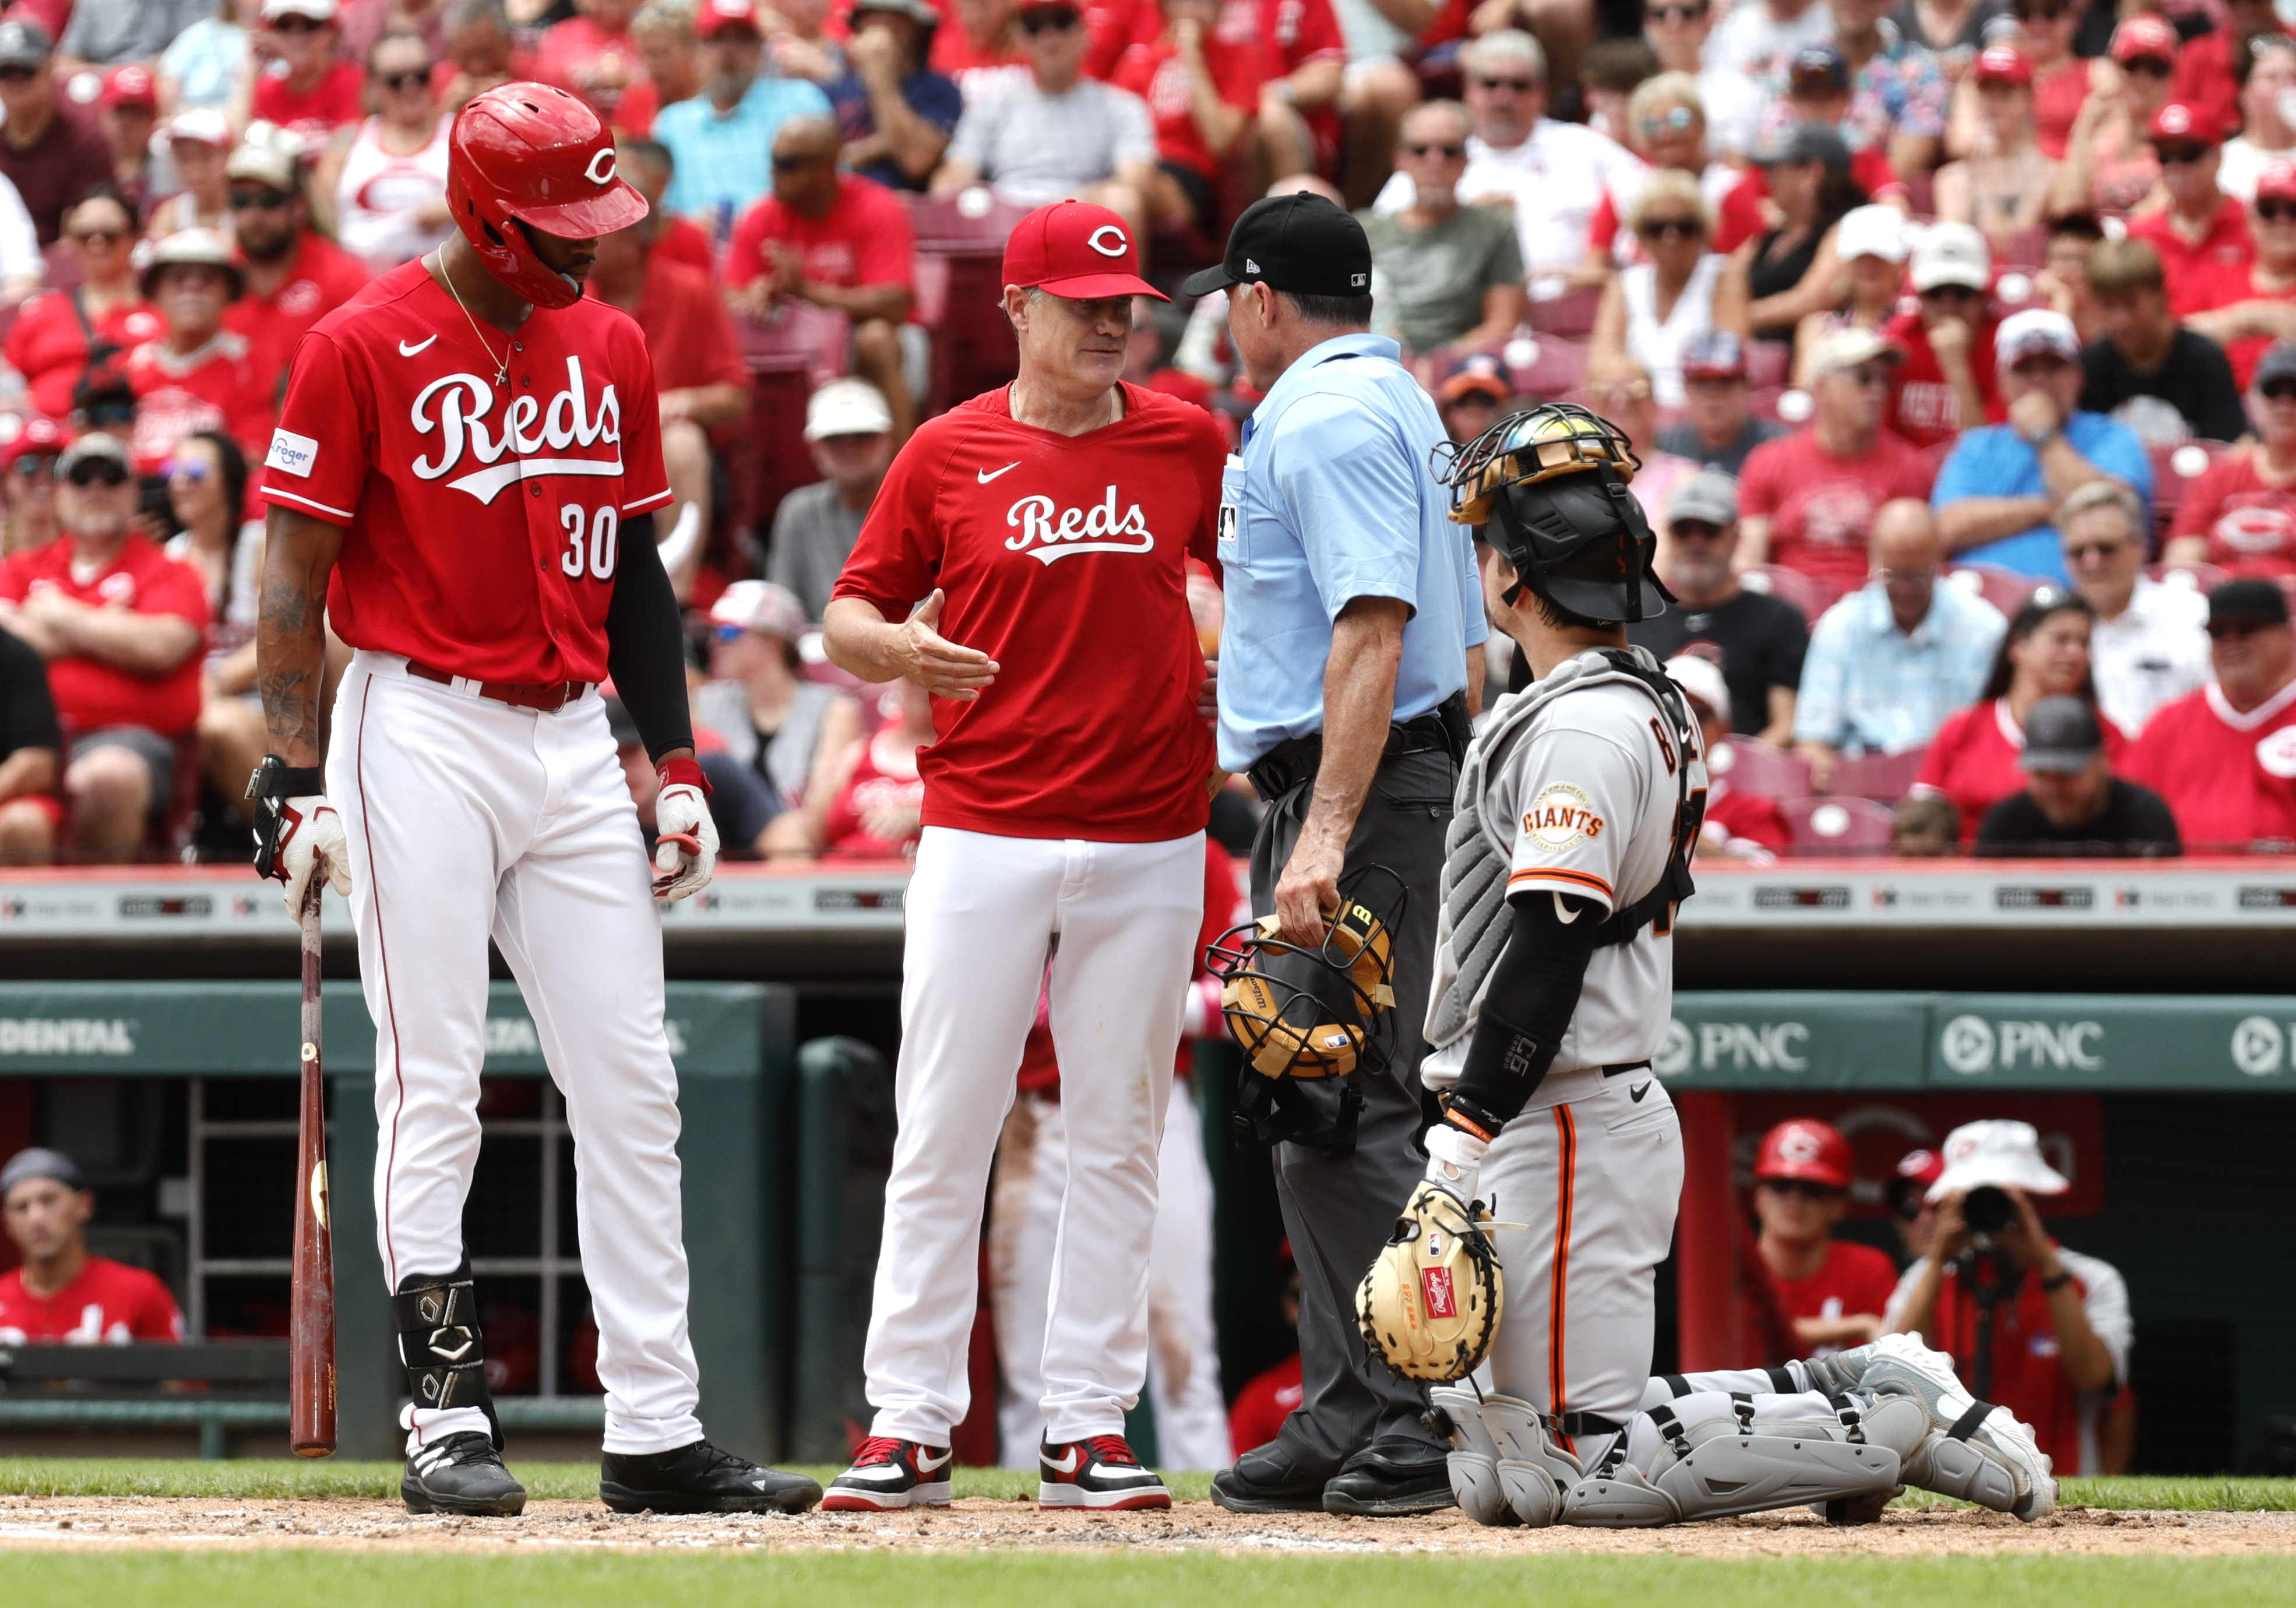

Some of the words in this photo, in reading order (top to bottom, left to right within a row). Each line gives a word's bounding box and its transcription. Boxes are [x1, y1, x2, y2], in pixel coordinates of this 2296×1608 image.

[584, 147, 616, 185] C
[1087, 225, 1128, 258] C
[411, 355, 624, 505] Reds
[561, 503, 619, 582] 30
[1005, 484, 1154, 567] Reds
[1523, 807, 1604, 839] GIANTS
[0, 1018, 136, 1056] DENTAL
[1698, 1022, 1809, 1072] PNC
[1999, 1021, 2105, 1072] PNC
[1429, 1271, 1448, 1313] Rawlings
